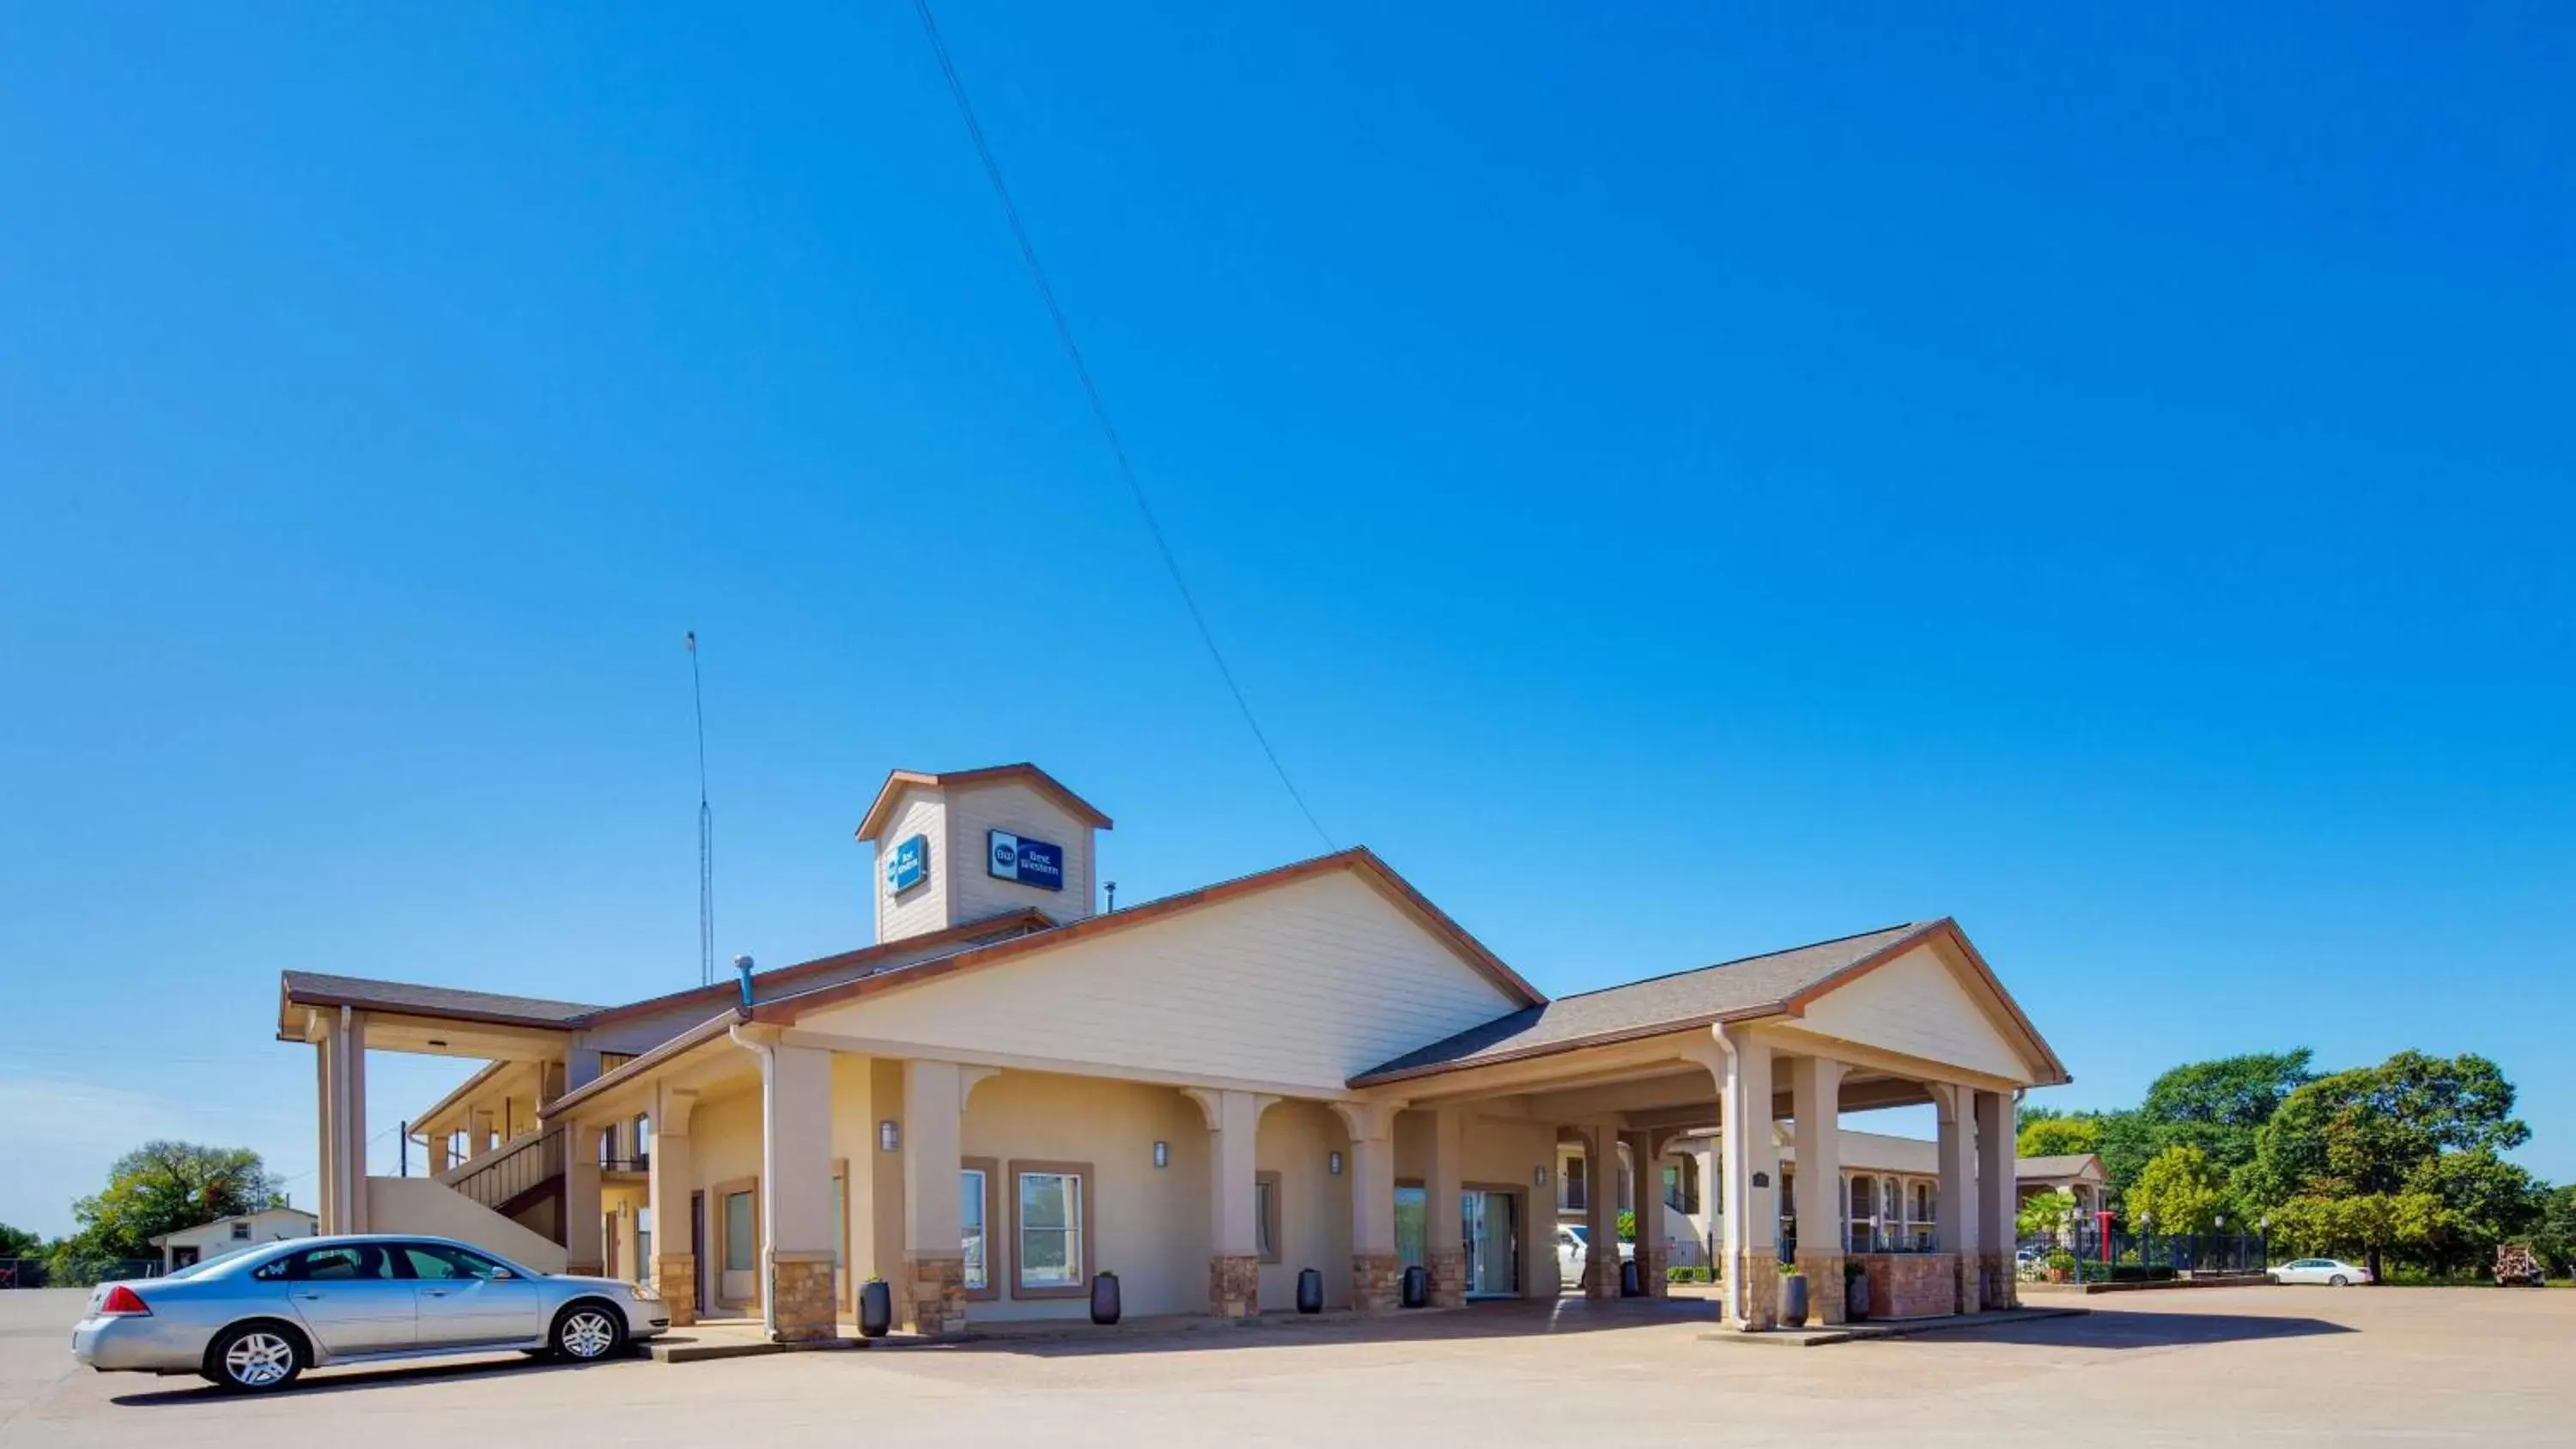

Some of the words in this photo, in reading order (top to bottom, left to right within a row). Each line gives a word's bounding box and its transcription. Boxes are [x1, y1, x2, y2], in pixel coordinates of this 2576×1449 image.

[997, 849, 1014, 861] BW
[1029, 851, 1050, 864] Best
[1020, 859, 1059, 876] Western
